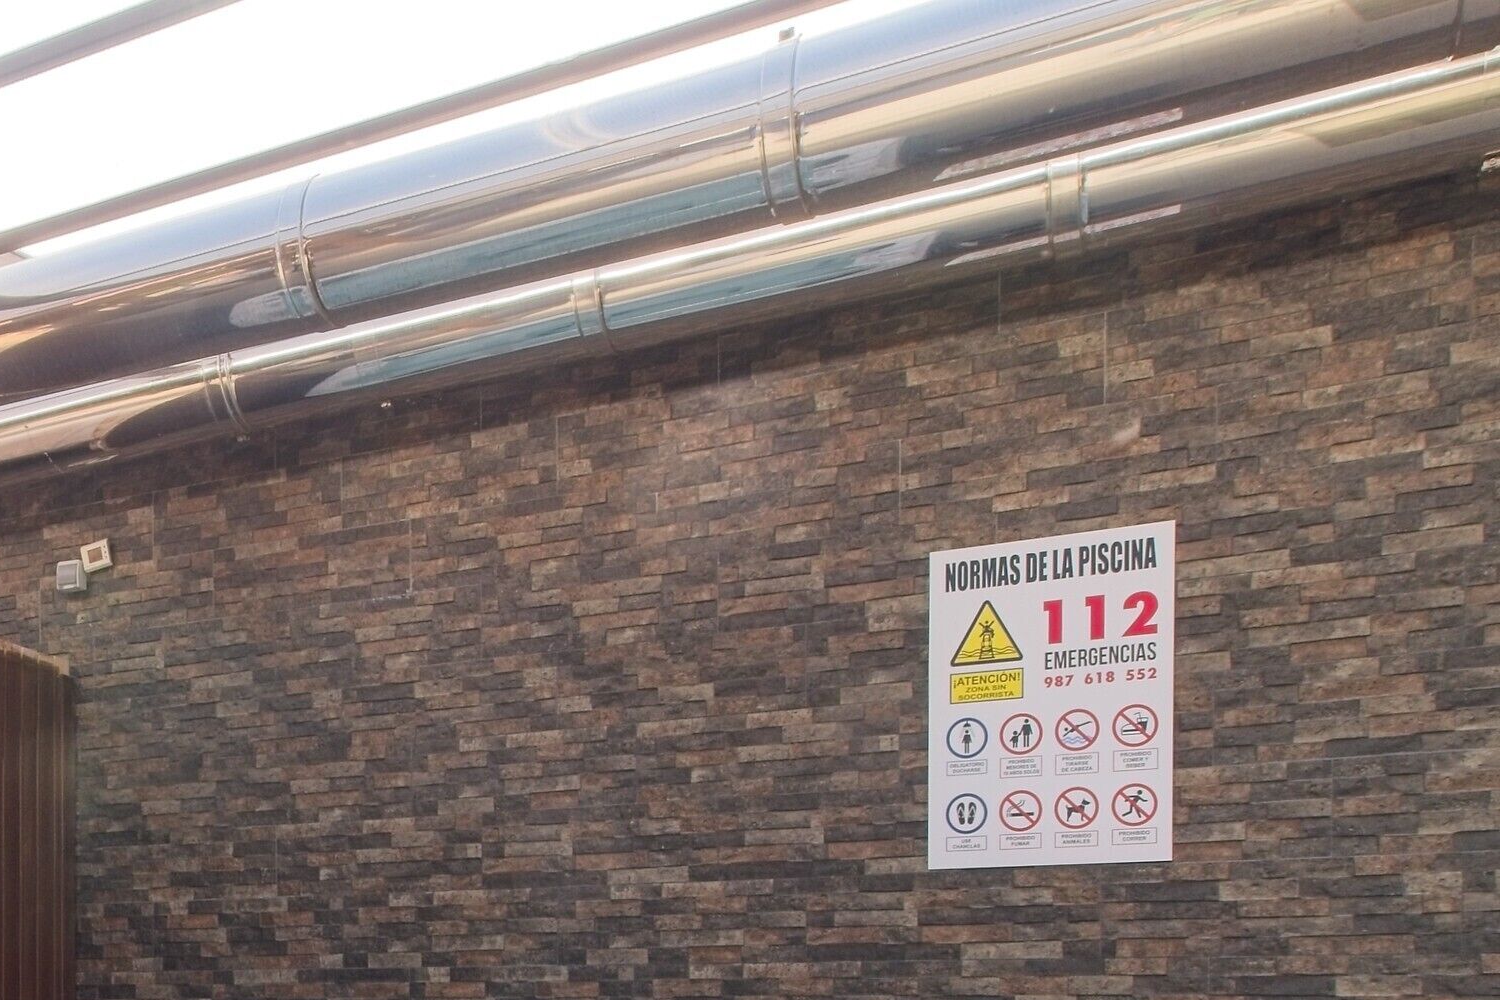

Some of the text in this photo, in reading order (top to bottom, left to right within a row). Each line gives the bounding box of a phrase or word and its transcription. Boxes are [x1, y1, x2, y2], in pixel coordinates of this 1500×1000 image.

[945, 536, 1158, 593] NORMAS DE LA PISCINA
[1043, 590, 1159, 645] 112
[1044, 641, 1157, 670] EMERGENCIAS
[953, 671, 1021, 689] ¡ATENCIÓN!
[1044, 667, 1157, 688] 987 618 552
[958, 691, 1014, 701] SOCORRISTA
